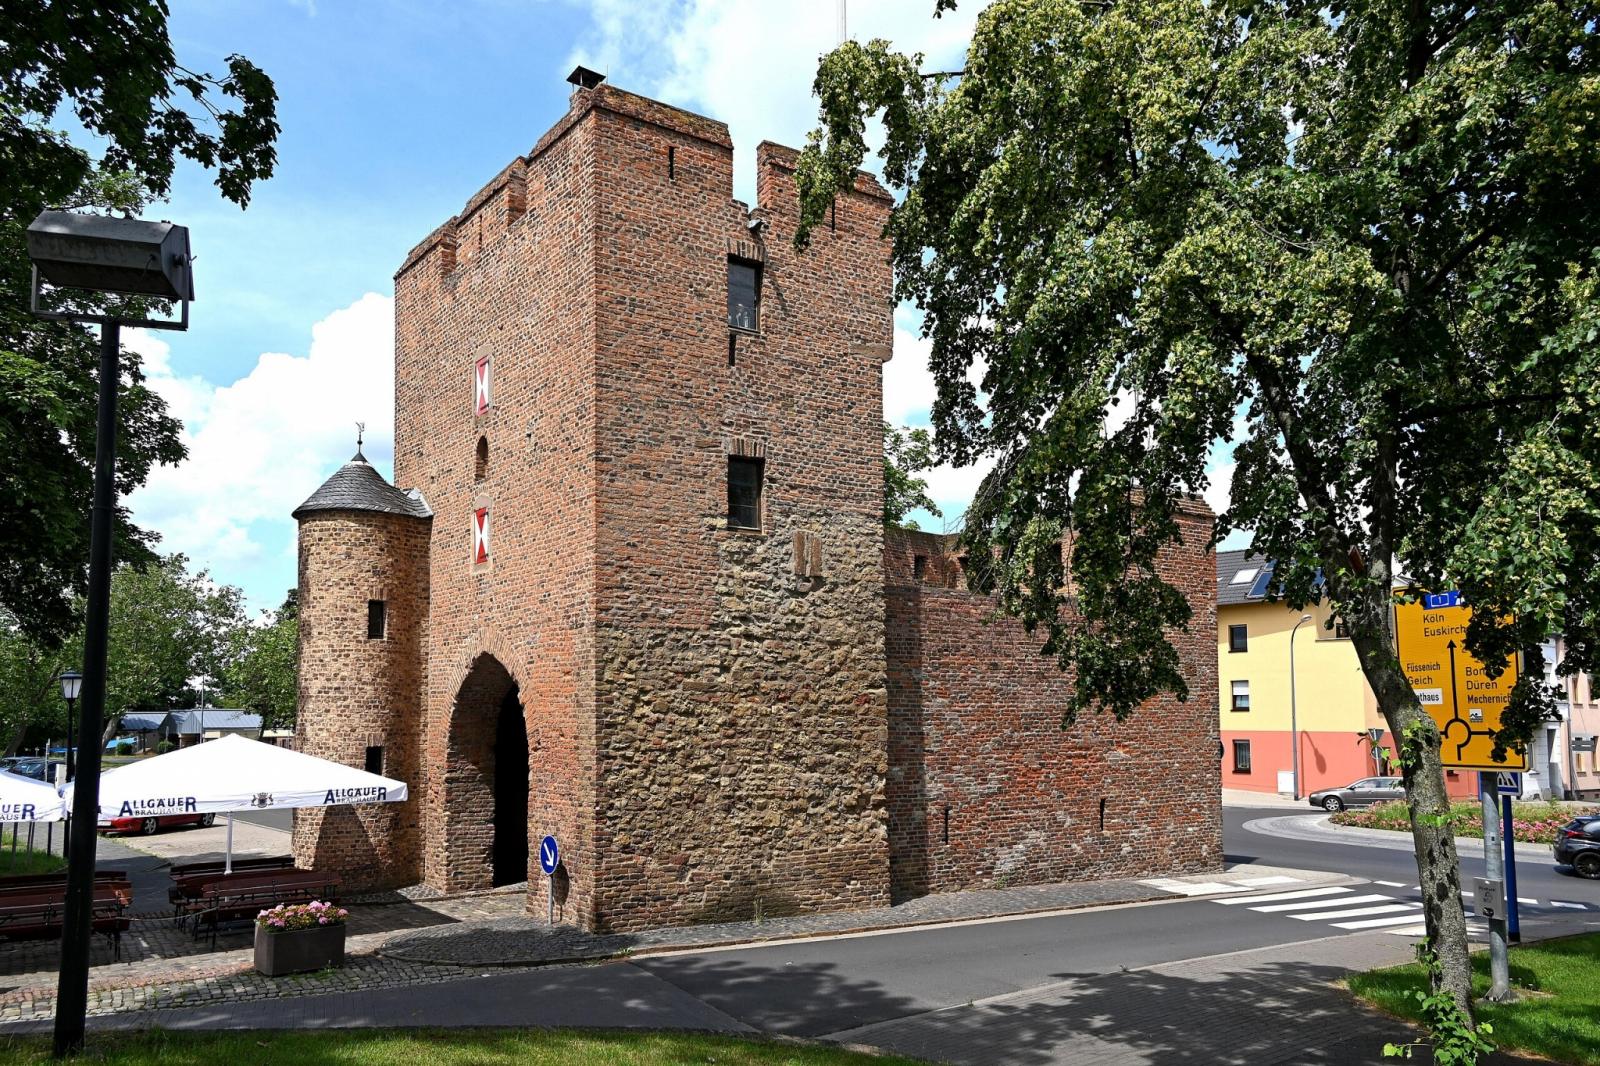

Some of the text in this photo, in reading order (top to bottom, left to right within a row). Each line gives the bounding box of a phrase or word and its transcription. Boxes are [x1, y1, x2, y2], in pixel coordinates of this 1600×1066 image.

[1424, 614, 1445, 624] Köln
[1424, 626, 1467, 637] Euskirch
[1406, 662, 1441, 672] Füssenich
[1465, 667, 1486, 676] Bon
[1408, 676, 1433, 685] Geich
[1466, 680, 1498, 690] Düren
[1417, 692, 1440, 702] thaus
[323, 787, 387, 804] ALLGÄUER
[0, 803, 36, 820] UER
[119, 797, 197, 817] ALLGÄUER
[135, 807, 183, 816] BRAUHAUS
